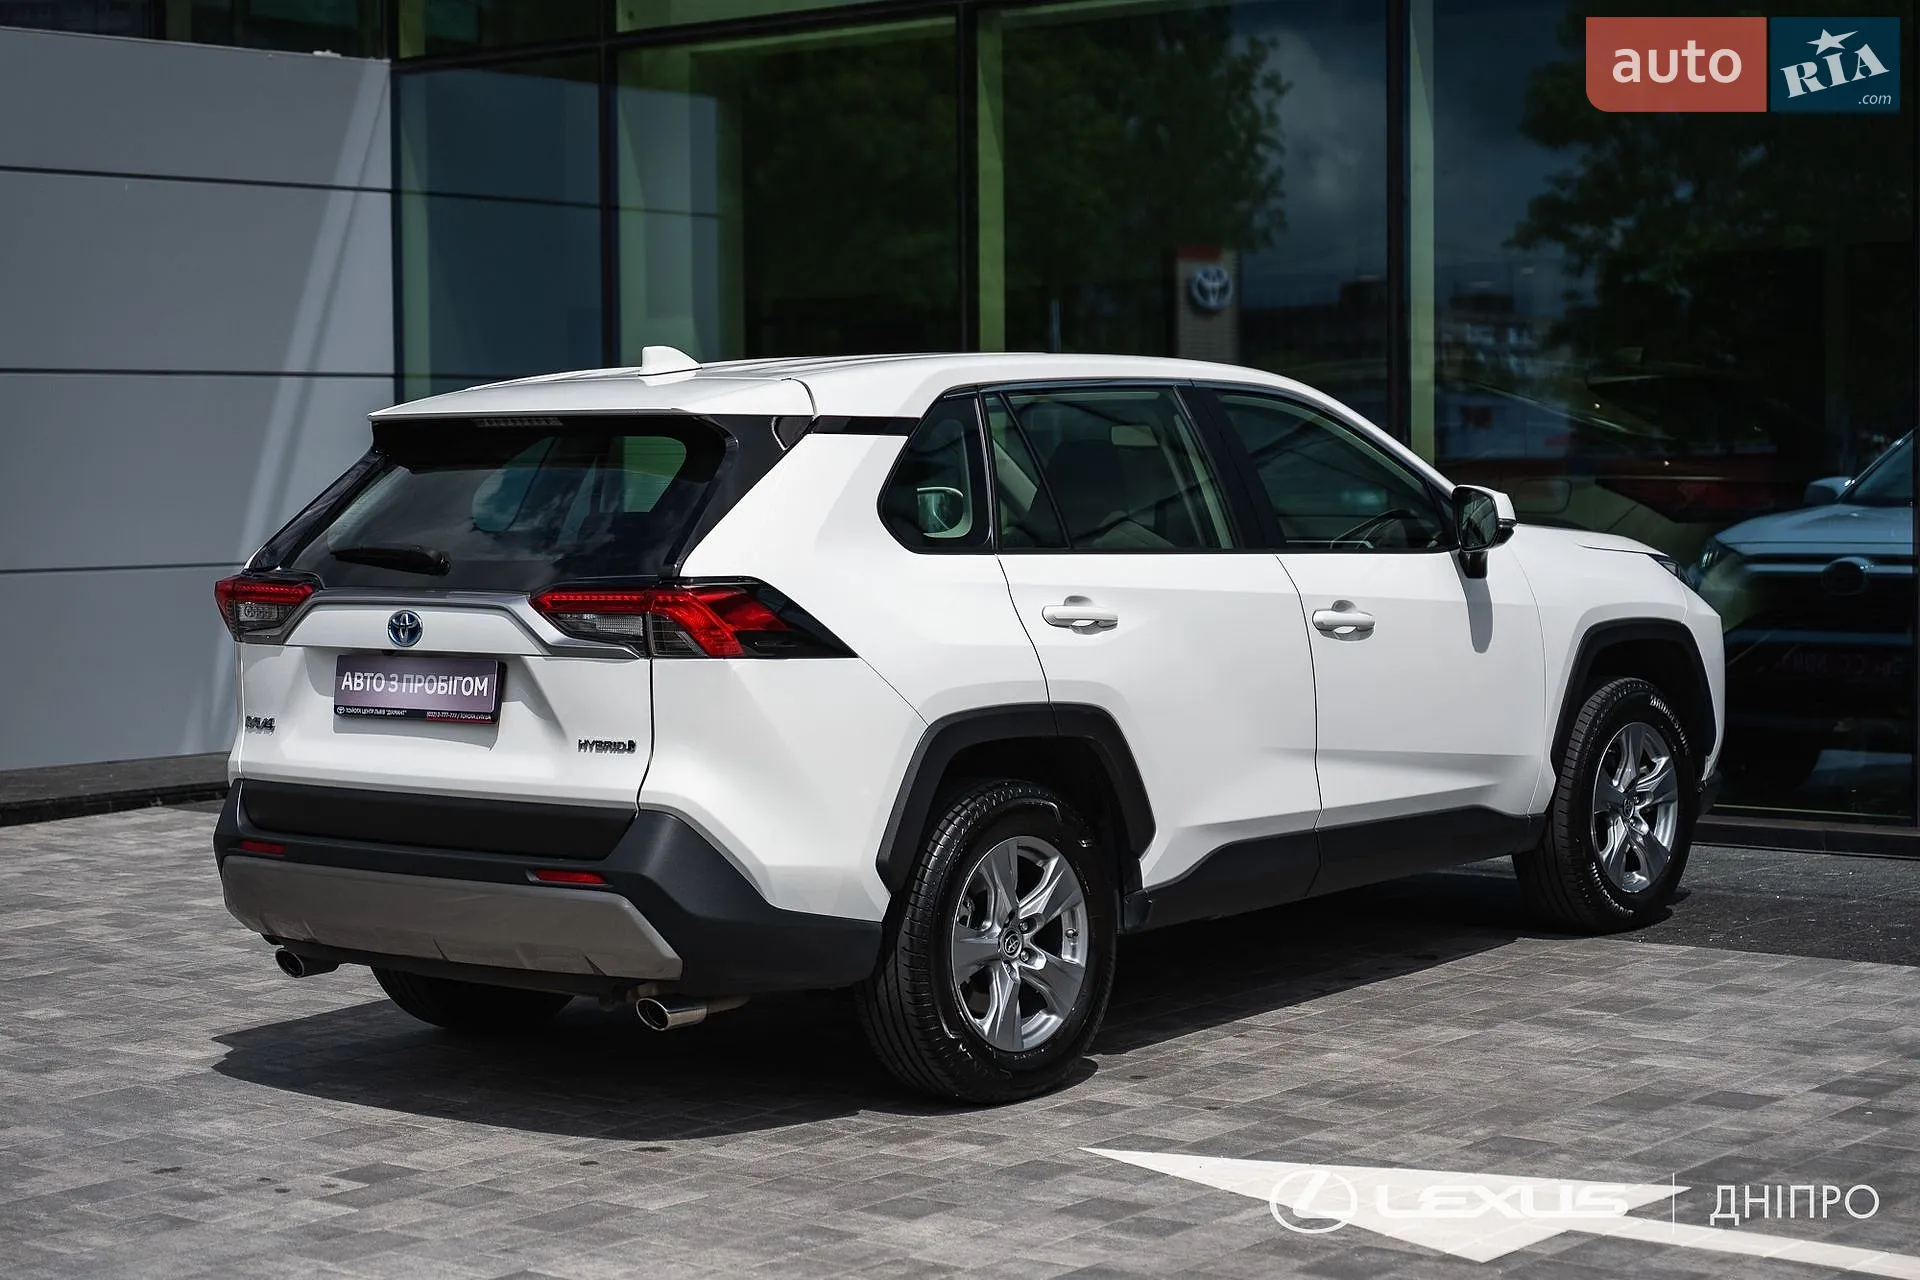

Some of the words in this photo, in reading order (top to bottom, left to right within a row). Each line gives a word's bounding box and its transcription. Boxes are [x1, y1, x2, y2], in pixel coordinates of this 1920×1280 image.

[341, 671, 385, 692] АВТО
[402, 674, 489, 697] ПРОБІГОМ
[578, 739, 626, 753] HYBRID
